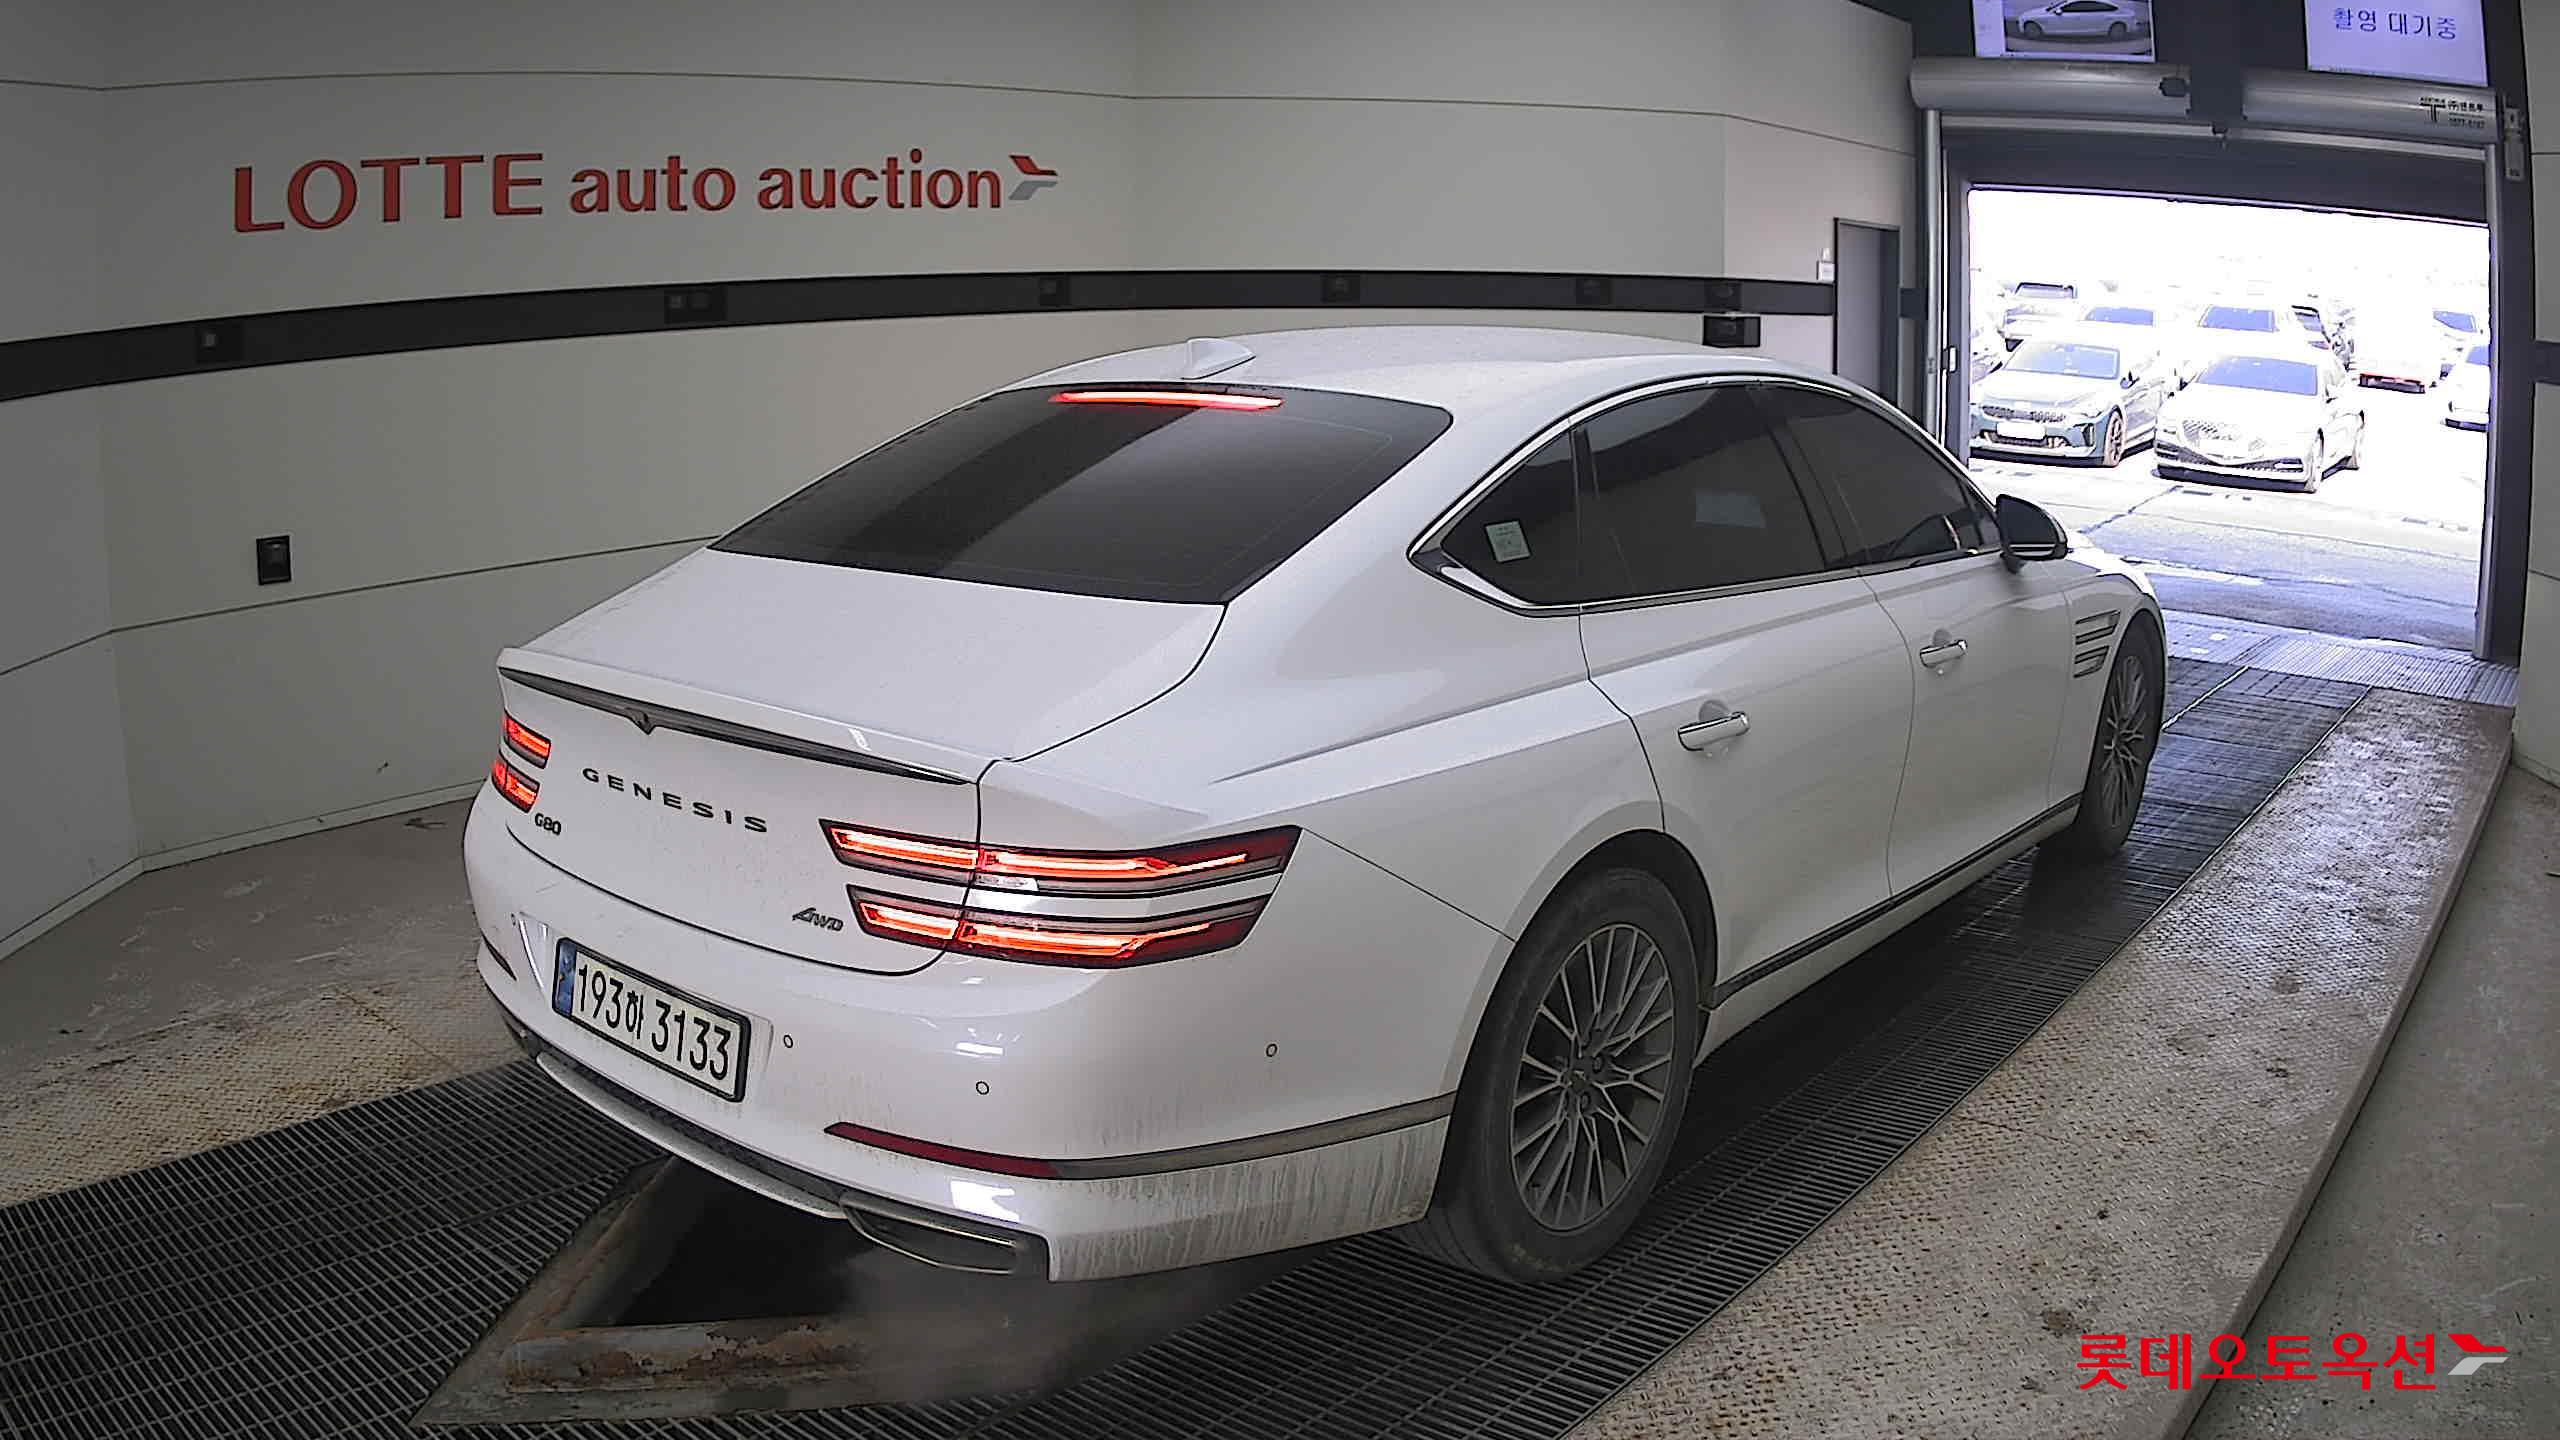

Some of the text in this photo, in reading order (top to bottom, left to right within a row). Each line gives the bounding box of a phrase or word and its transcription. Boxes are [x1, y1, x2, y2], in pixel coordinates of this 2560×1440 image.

[2388, 12, 2456, 40] 대기중
[234, 148, 1000, 232] LOTTE auto auction
[582, 768, 767, 833] GENESIS
[534, 812, 562, 836] G80
[792, 907, 844, 931] AWD
[579, 964, 731, 1080] 193하 3133
